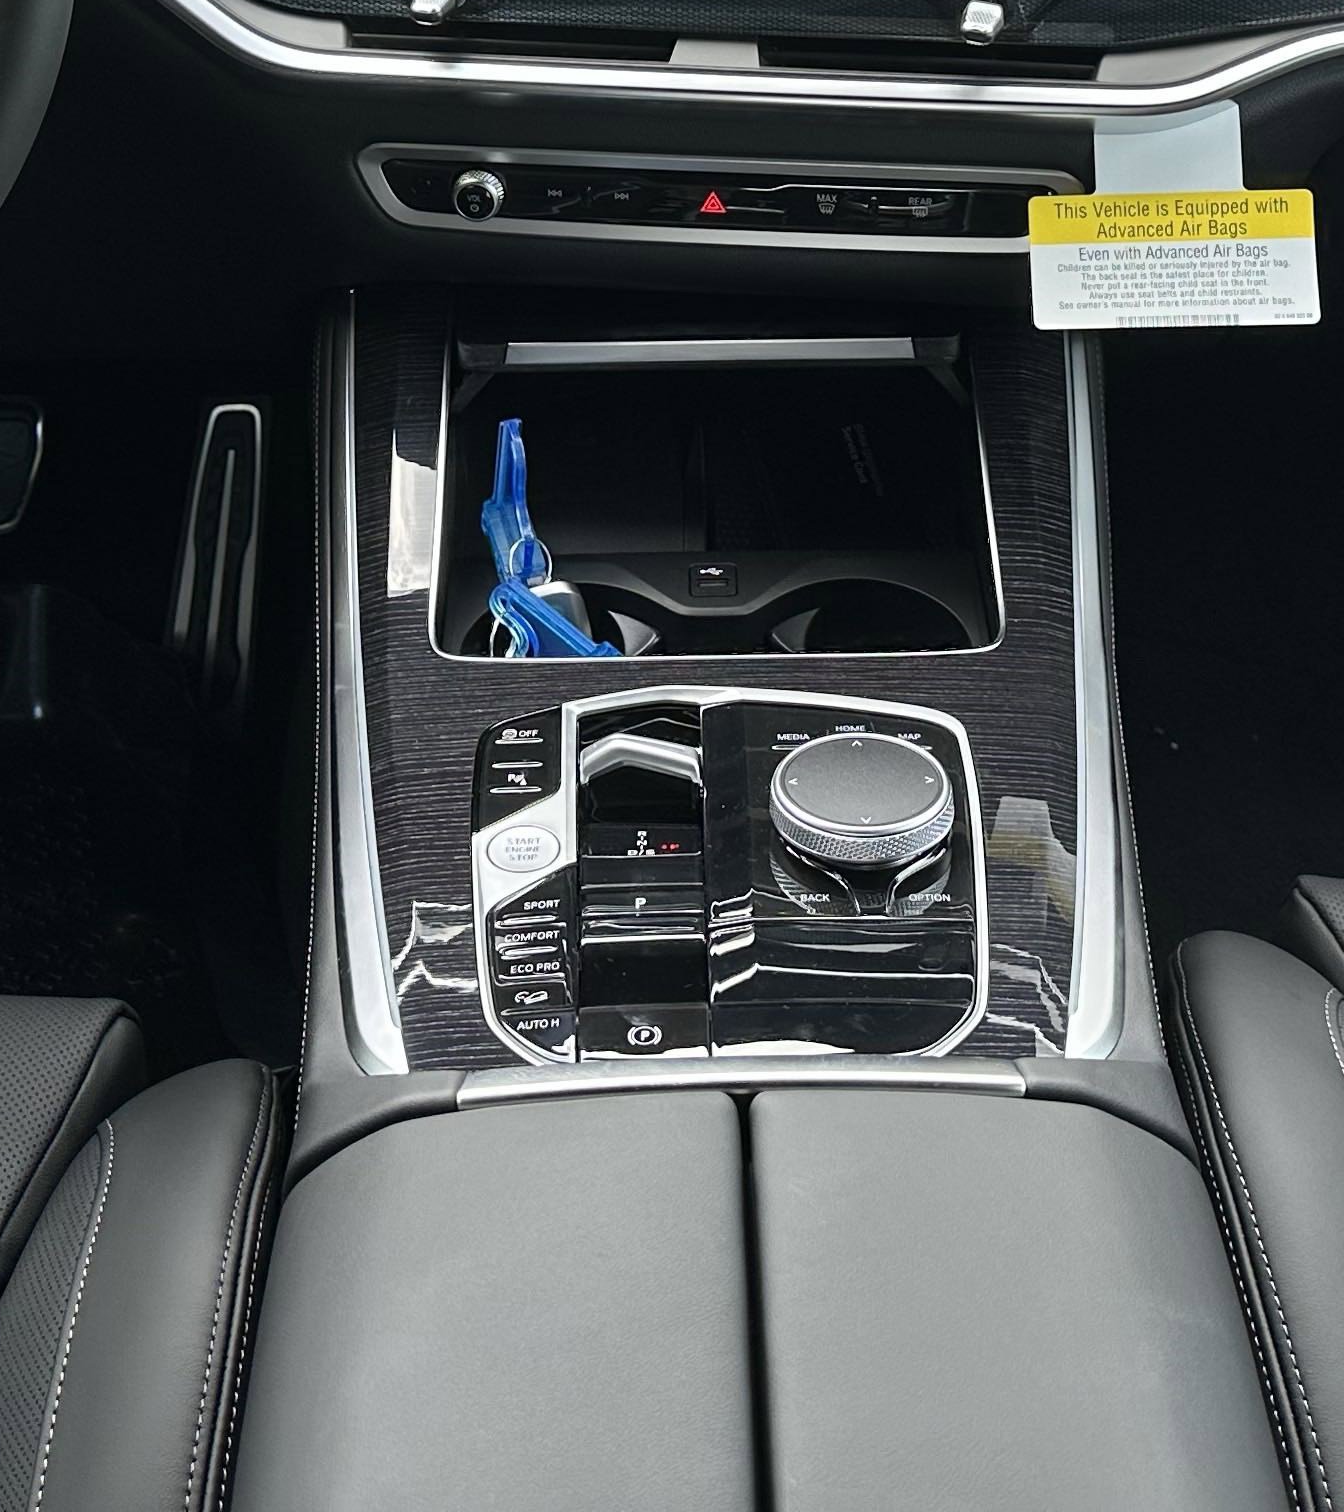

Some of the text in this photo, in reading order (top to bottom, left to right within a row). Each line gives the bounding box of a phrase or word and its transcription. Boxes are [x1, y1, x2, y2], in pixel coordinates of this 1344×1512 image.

[816, 193, 837, 203] MAX
[908, 197, 932, 206] REAR
[1054, 197, 1289, 219] This Vehicle is Equipped with
[1097, 219, 1247, 239] Advanced Air Bags
[1079, 243, 1268, 261] Even with Advanced Air Bags
[1057, 263, 1091, 272] Children
[1111, 263, 1121, 271] be
[1124, 262, 1146, 270] killed
[1200, 260, 1228, 270] injured
[1232, 261, 1243, 269] by
[1081, 273, 1096, 281] The
[1099, 272, 1118, 281] back
[1120, 272, 1137, 280] seat
[1150, 271, 1163, 279] the
[1193, 270, 1214, 279] place
[1081, 282, 1104, 290] Never
[1107, 282, 1121, 290] put
[1131, 280, 1176, 289] rear-facing
[1177, 279, 1198, 288] child
[1231, 279, 1244, 287] the
[1089, 291, 1117, 300] Always
[1120, 291, 1135, 299] use
[1137, 290, 1155, 298] seat
[1157, 289, 1177, 298] belts
[1180, 289, 1195, 297] and
[1197, 288, 1217, 296] child
[1058, 301, 1074, 309] See
[1111, 300, 1140, 308] manual
[1143, 299, 1155, 307] for
[1158, 299, 1180, 307] more
[1182, 298, 1230, 306] information
[1232, 297, 1256, 305] about
[1259, 296, 1270, 304] air
[518, 729, 539, 738] OFF
[776, 733, 811, 741] MEDIA
[635, 897, 647, 910] P
[799, 892, 831, 903] BACK
[908, 892, 952, 903] OPTION
[523, 899, 561, 911] SPORT
[504, 930, 560, 942] COMFORT
[510, 961, 561, 974] ECO PRO
[516, 1017, 560, 1030] AUTO H
